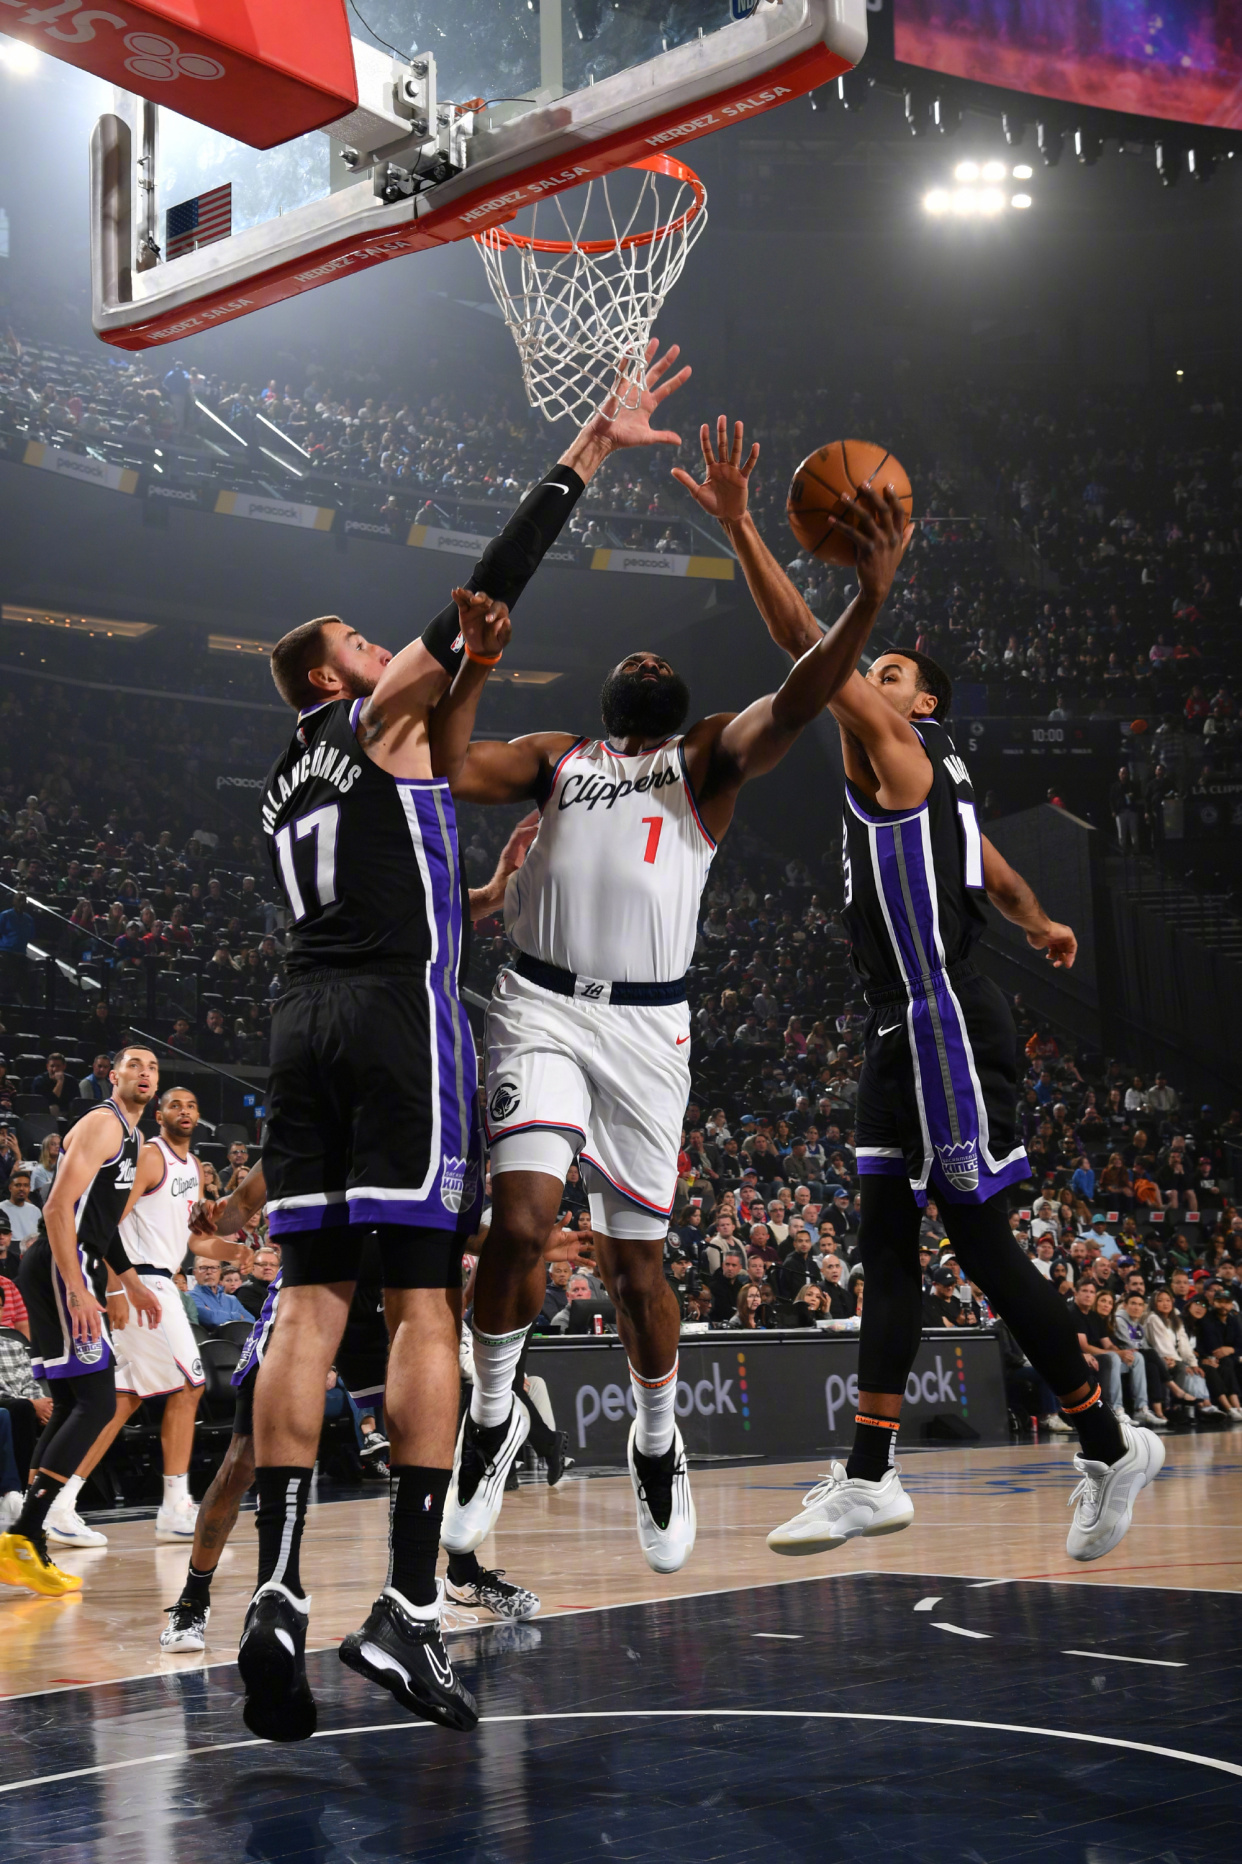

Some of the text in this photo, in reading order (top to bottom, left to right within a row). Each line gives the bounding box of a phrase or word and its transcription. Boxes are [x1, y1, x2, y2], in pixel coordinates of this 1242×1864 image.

[644, 86, 792, 147] HERDEZ SALSA
[459, 165, 592, 223] HERDEZ SALSA
[294, 240, 412, 283] HERDEZ SALSA
[147, 297, 254, 341] HERDEZ SALSA
[56, 457, 104, 478] peacock
[148, 484, 198, 501] peacock
[250, 502, 298, 519] peacock
[344, 518, 392, 535] peacock
[437, 534, 483, 551] peacock
[542, 550, 576, 562] acock
[623, 556, 671, 570] peacock
[968, 738, 978, 751] 5
[1032, 729, 1064, 742] 10:00
[558, 766, 680, 811] Clippers
[642, 816, 664, 865] 1
[273, 801, 341, 922] 17
[581, 982, 605, 999] LA
[943, 1161, 978, 1174] KINGS
[171, 1177, 199, 1198] Clippers
[825, 1355, 958, 1431] peock
[575, 1362, 738, 1448] peock
